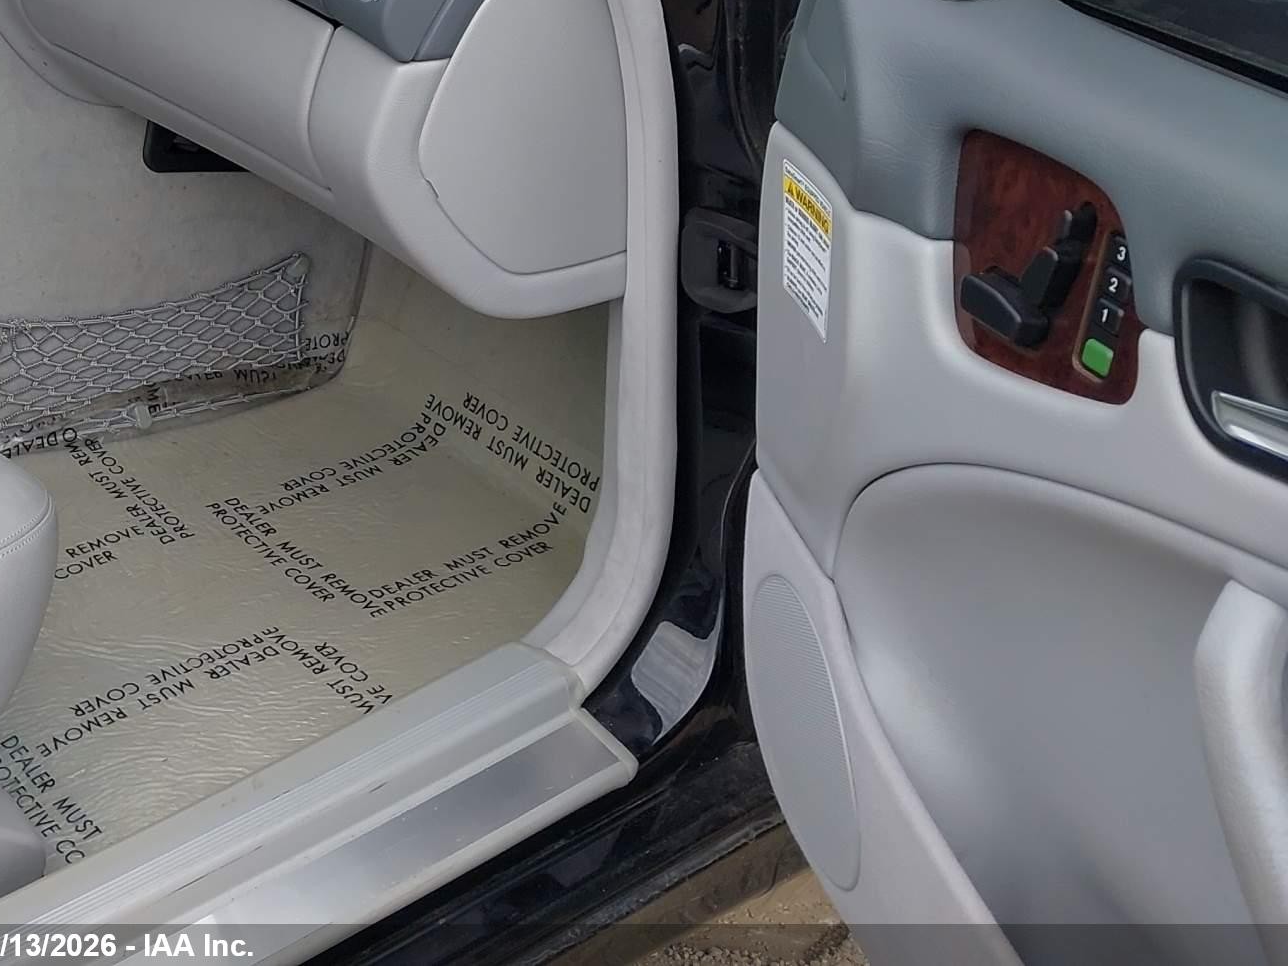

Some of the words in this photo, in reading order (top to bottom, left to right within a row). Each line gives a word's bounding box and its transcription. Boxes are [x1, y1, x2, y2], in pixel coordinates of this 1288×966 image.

[793, 184, 830, 235] WARNING
[1116, 246, 1127, 261] 3
[1108, 277, 1119, 293] 2
[1101, 308, 1109, 323] 1
[424, 393, 483, 441] REMOVE
[463, 392, 509, 431] COVER
[84, 437, 125, 475] COVER
[339, 412, 432, 471] PROTECTIVE
[388, 423, 447, 466] DEALER
[486, 437, 529, 471] MUST
[512, 425, 600, 492] PROTECTIVE
[89, 471, 128, 499] MUST
[279, 467, 337, 492] COVER
[336, 464, 384, 488] MUST
[536, 466, 591, 514] DEALER
[121, 477, 195, 539] PROTECTIVE
[255, 484, 331, 515] REMOVE
[66, 525, 146, 559] REMOVE
[126, 503, 176, 545] DEALER
[54, 550, 118, 580] COVER
[205, 502, 288, 567] PROTECTIVE
[284, 567, 337, 603] COVER
[224, 497, 277, 538] DEALER
[275, 540, 323, 571] MUST
[320, 572, 388, 619] REMOVE
[368, 568, 441, 599] DEALER
[443, 546, 495, 572] MUST
[497, 501, 568, 550] REMOVE
[383, 564, 493, 612] PROTECTIVE
[493, 540, 554, 568] COVER
[145, 632, 266, 687] PROTECTIVE
[203, 645, 280, 680] DEALER
[261, 626, 331, 675] REMOVE
[314, 641, 369, 683] COVER
[69, 682, 141, 718] COVER
[135, 677, 197, 711] MUST
[35, 706, 129, 758] REMOVE
[0, 734, 57, 794] DEALER
[52, 795, 104, 841] MUST
